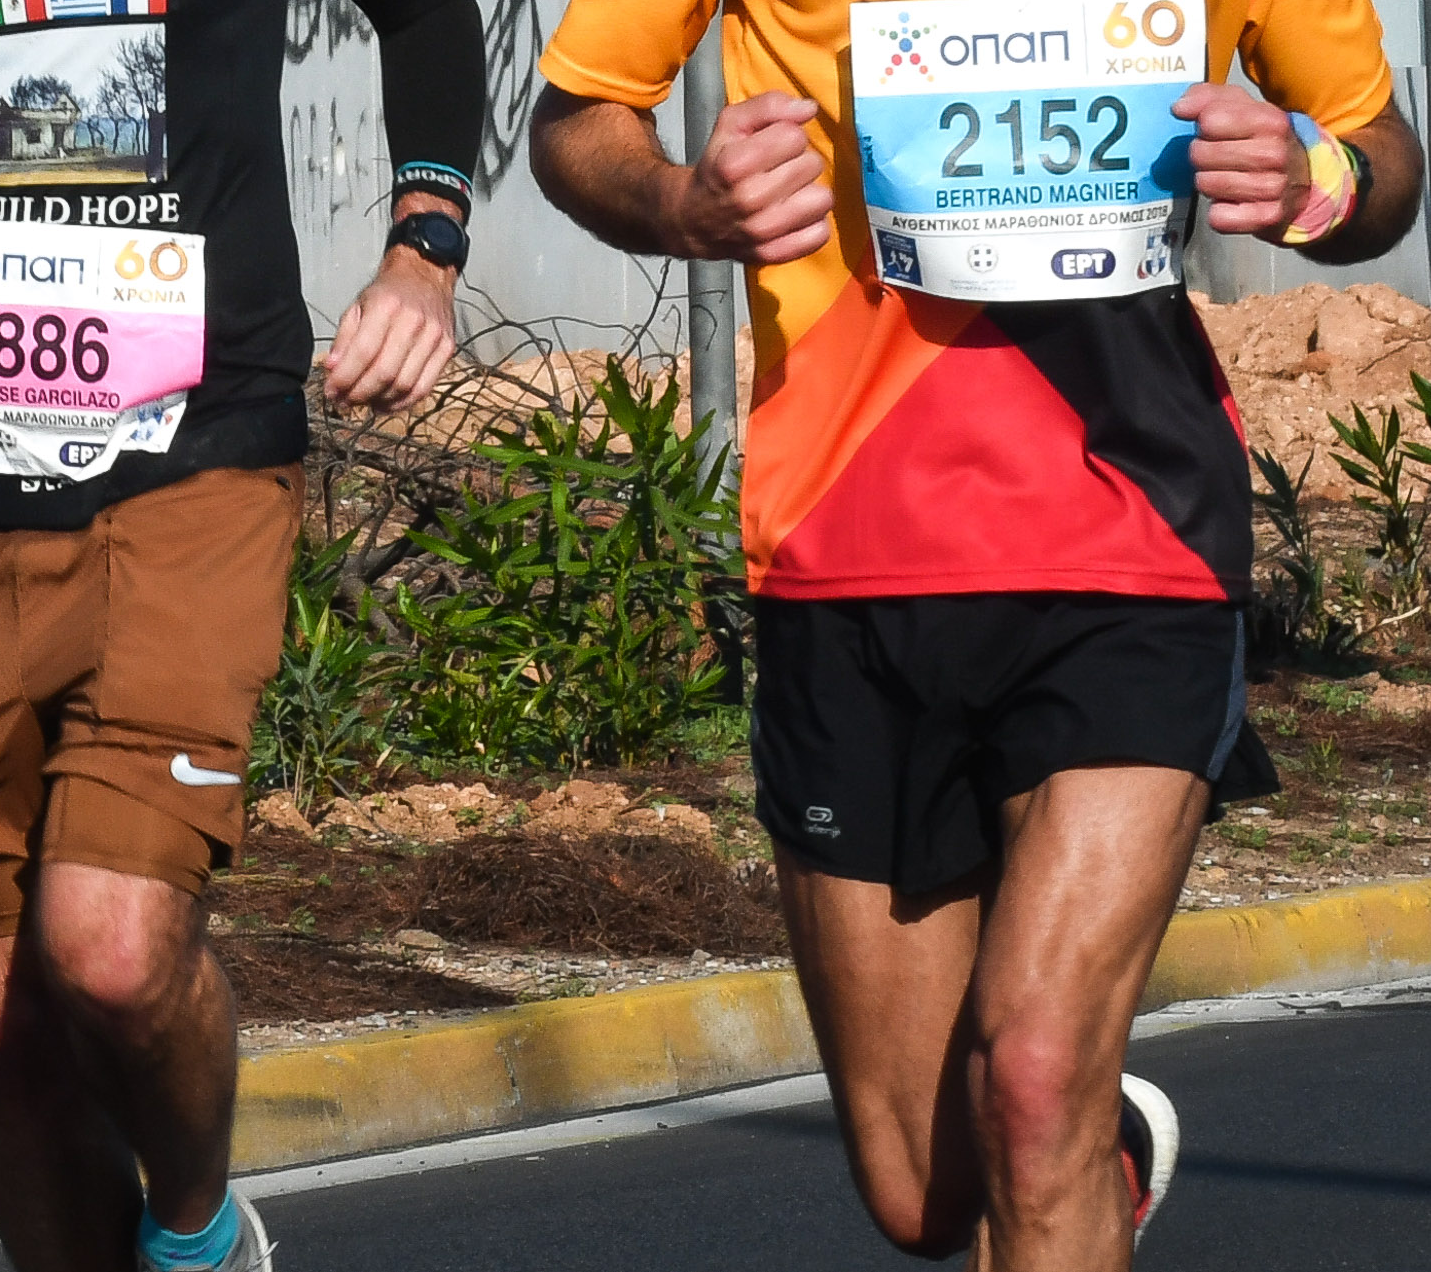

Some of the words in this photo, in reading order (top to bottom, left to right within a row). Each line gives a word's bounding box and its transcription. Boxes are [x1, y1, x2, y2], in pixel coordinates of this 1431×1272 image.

[1105, 55, 1188, 75] ΧΡΟΝΙΑ
[939, 95, 1131, 179] 2152
[79, 192, 182, 224] HOPE
[936, 185, 1043, 209] BERTRAND
[1048, 181, 1138, 205] MAGNIER
[891, 215, 982, 232] ΑΥΘΕΝΤΙΚΟΣ
[984, 212, 1085, 230] ΜΑΡΑΘΩΝΙΟΣ
[1088, 209, 1145, 225] ΔΡΟΜΟΣ
[1145, 204, 1169, 222] 2018
[113, 239, 188, 282] 60
[1061, 253, 1108, 276] ΕΡΤ
[112, 286, 187, 305] ΧΡΟΝΙΑ
[24, 386, 122, 410] GARCILAZO
[2, 409, 88, 428] ΜΑΡΑΘΩΝΙΟΣ
[90, 415, 117, 428] ΔΡΟ
